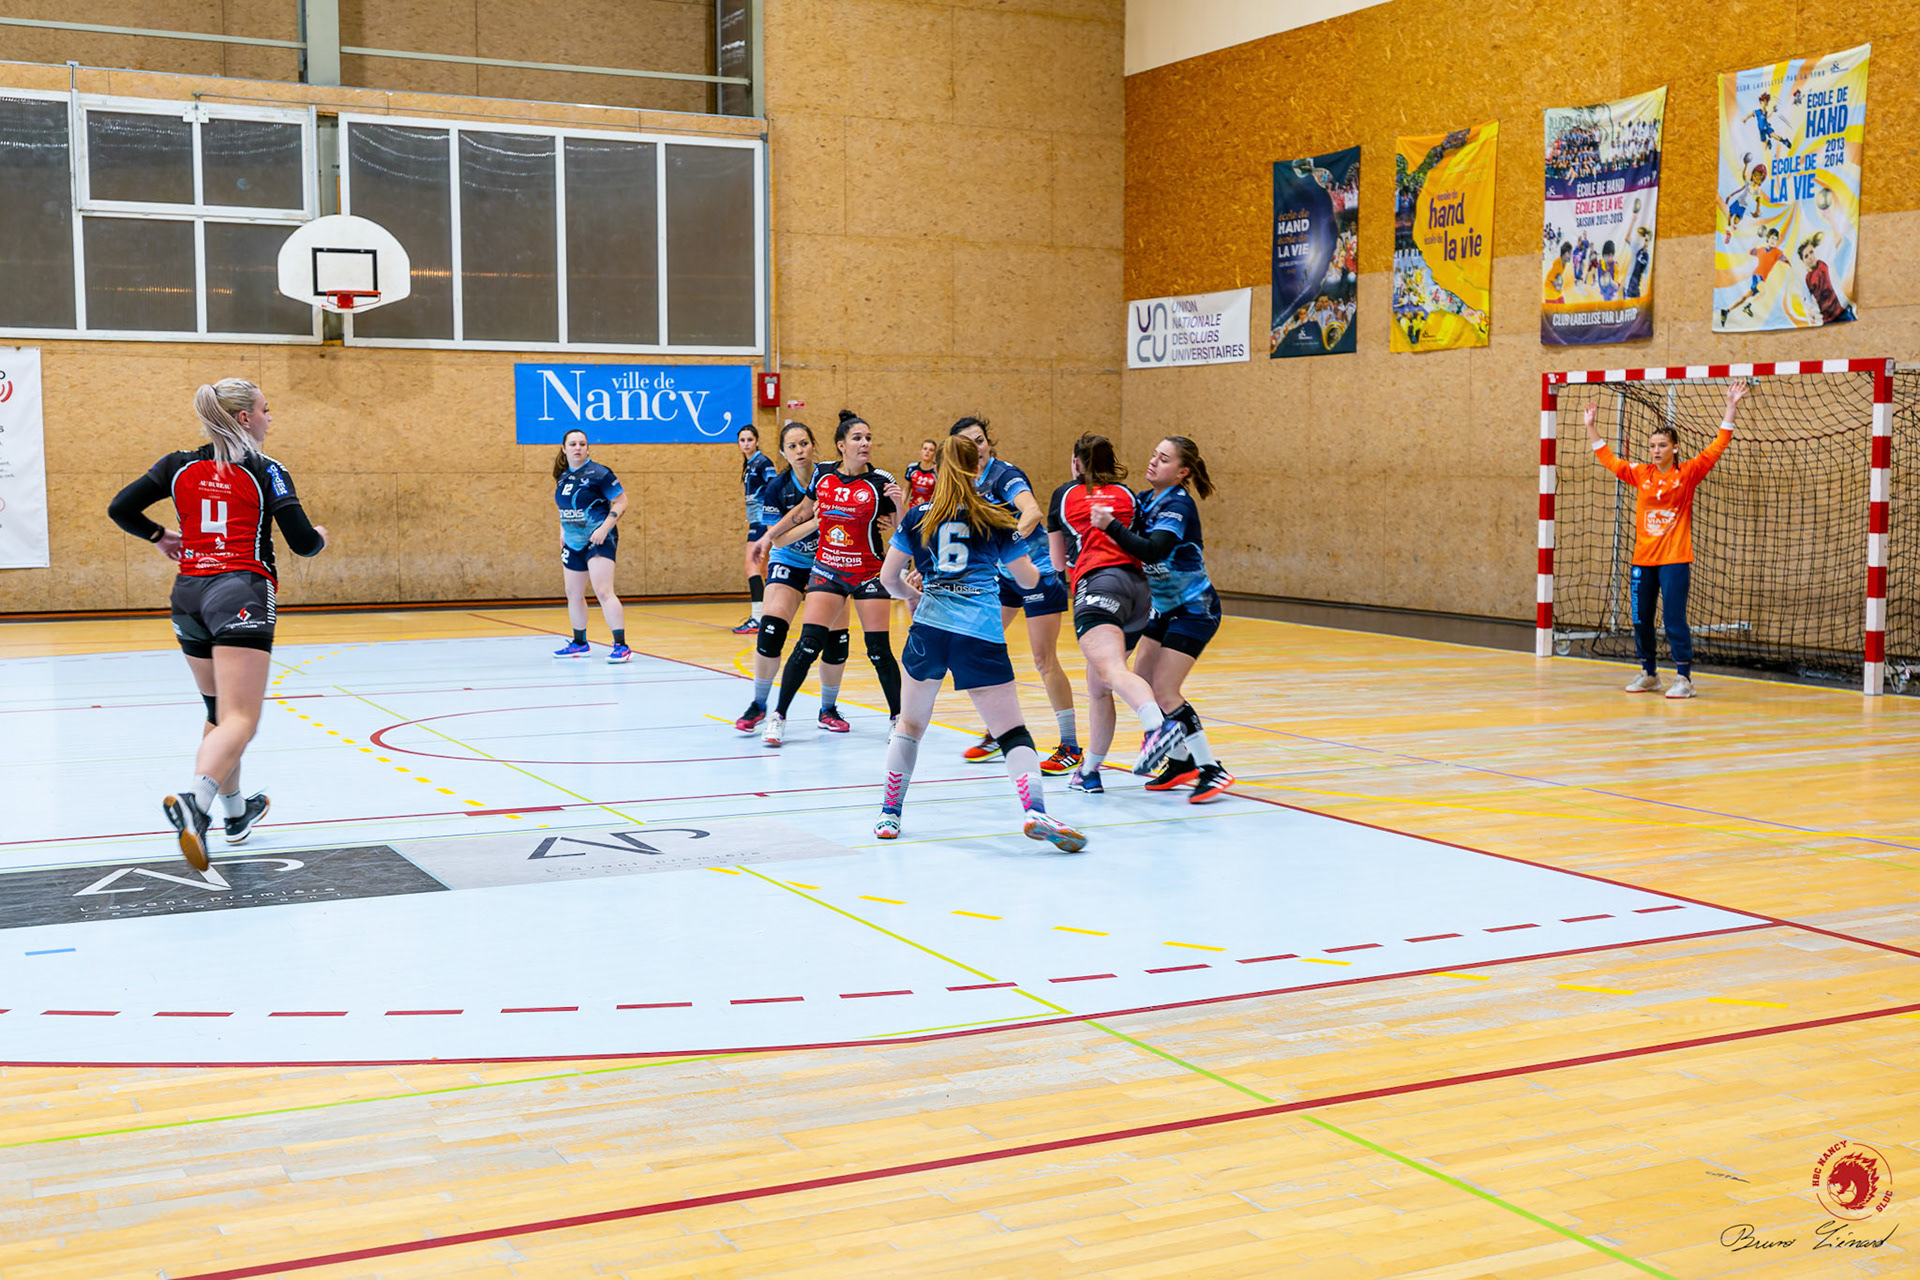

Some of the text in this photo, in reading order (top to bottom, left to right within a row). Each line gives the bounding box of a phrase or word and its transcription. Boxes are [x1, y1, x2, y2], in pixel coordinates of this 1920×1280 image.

[1807, 86, 1848, 109] ÉCOLE DE
[1805, 104, 1848, 138] HAND
[1825, 137, 1845, 153] 2013
[1771, 153, 1817, 176] ÉCOLE DE
[1824, 152, 1844, 168] 2014
[1597, 180, 1606, 194] DE
[1607, 178, 1625, 193] HAND
[1770, 173, 1816, 203] LA VIE
[1429, 192, 1465, 230] hand
[1596, 199, 1604, 213] DE
[1605, 198, 1613, 211] LA
[1614, 196, 1624, 210] VIE
[1278, 218, 1310, 235] HAND
[1576, 216, 1595, 228] SAISON
[1278, 243, 1309, 258] LA VIE
[1444, 227, 1482, 262] la vie
[1171, 300, 1199, 314] UNION
[1172, 314, 1222, 329] NATIONALE
[1171, 330, 1220, 346] DES CLUBS
[1171, 344, 1245, 362] UNIVERSITAIRES
[611, 371, 675, 390] ville de
[536, 370, 732, 437] Nancy
[561, 483, 574, 496] 12
[820, 502, 832, 510] Guy
[201, 498, 228, 539] 4
[938, 522, 970, 574] 6
[822, 552, 863, 564] COMPTOIR
[771, 564, 791, 579] 10
